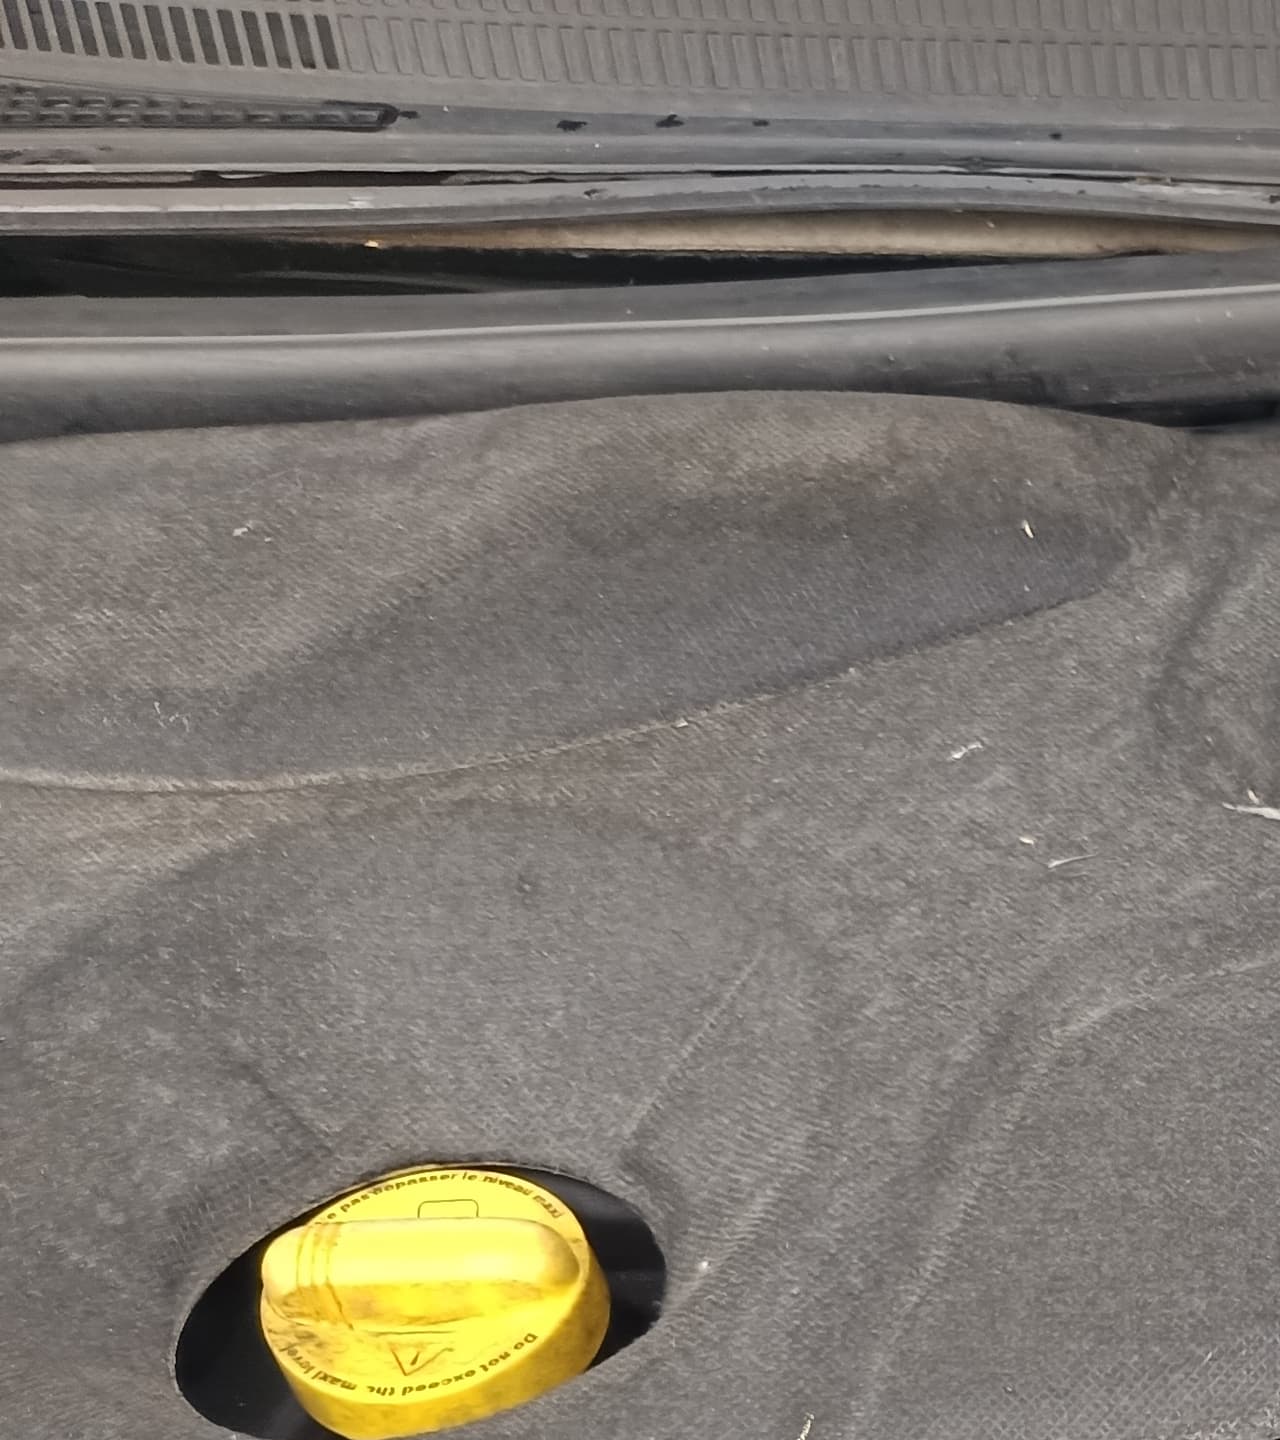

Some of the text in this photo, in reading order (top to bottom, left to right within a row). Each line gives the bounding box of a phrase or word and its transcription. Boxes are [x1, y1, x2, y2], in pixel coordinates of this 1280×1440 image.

[340, 1193, 370, 1213] pas
[462, 1171, 478, 1181] le
[482, 1175, 534, 1196] niveau
[513, 1332, 538, 1350] Do
[480, 1351, 511, 1372] not
[311, 1370, 357, 1391] maxi
[366, 1385, 396, 1396] the
[401, 1369, 477, 1396] exceed
